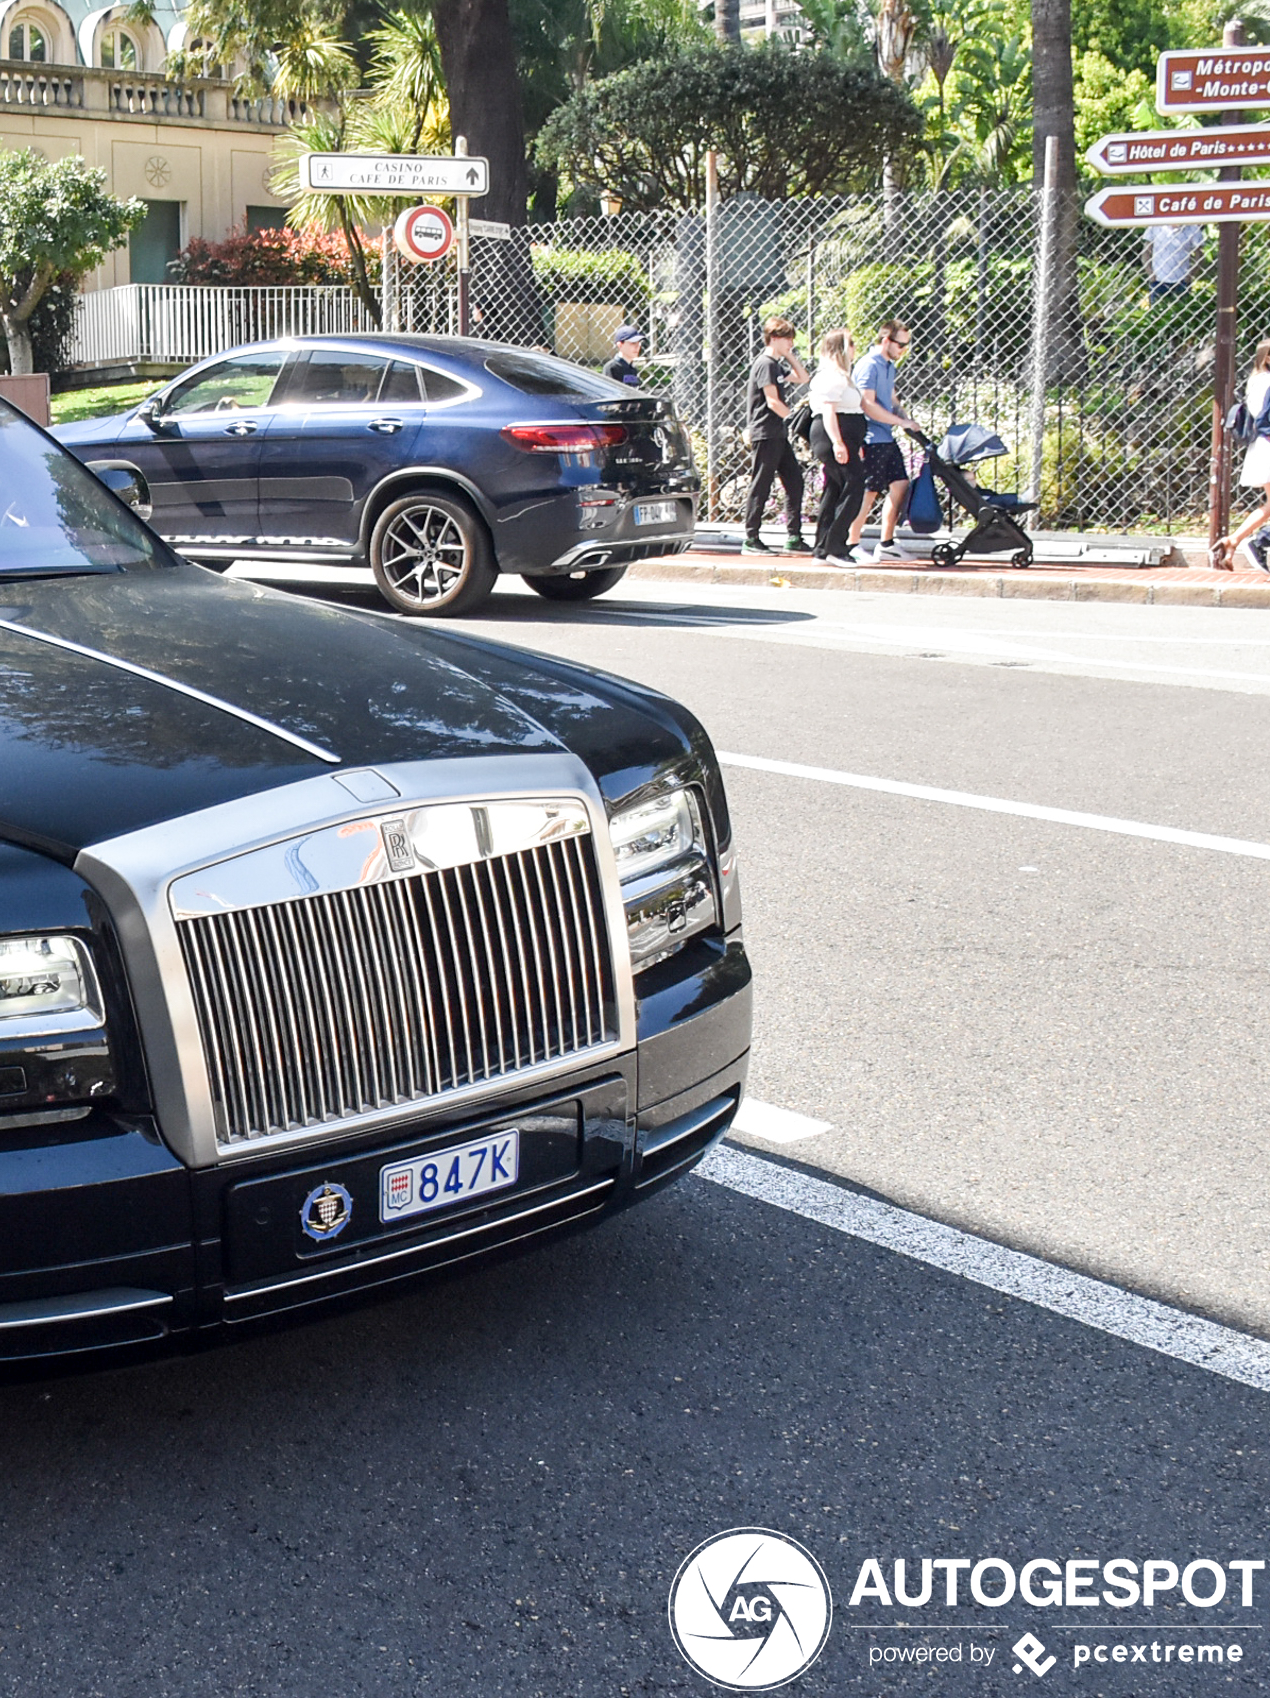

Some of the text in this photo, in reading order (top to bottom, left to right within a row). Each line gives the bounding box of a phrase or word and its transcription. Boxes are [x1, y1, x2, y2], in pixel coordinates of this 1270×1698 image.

[1129, 140, 1226, 160] Hôtel de Paris
[374, 162, 423, 173] CASINO
[349, 173, 448, 186] CAFE DE PARIS
[1159, 193, 1270, 213] Café de Paris
[391, 1139, 511, 1205] MC 847K
